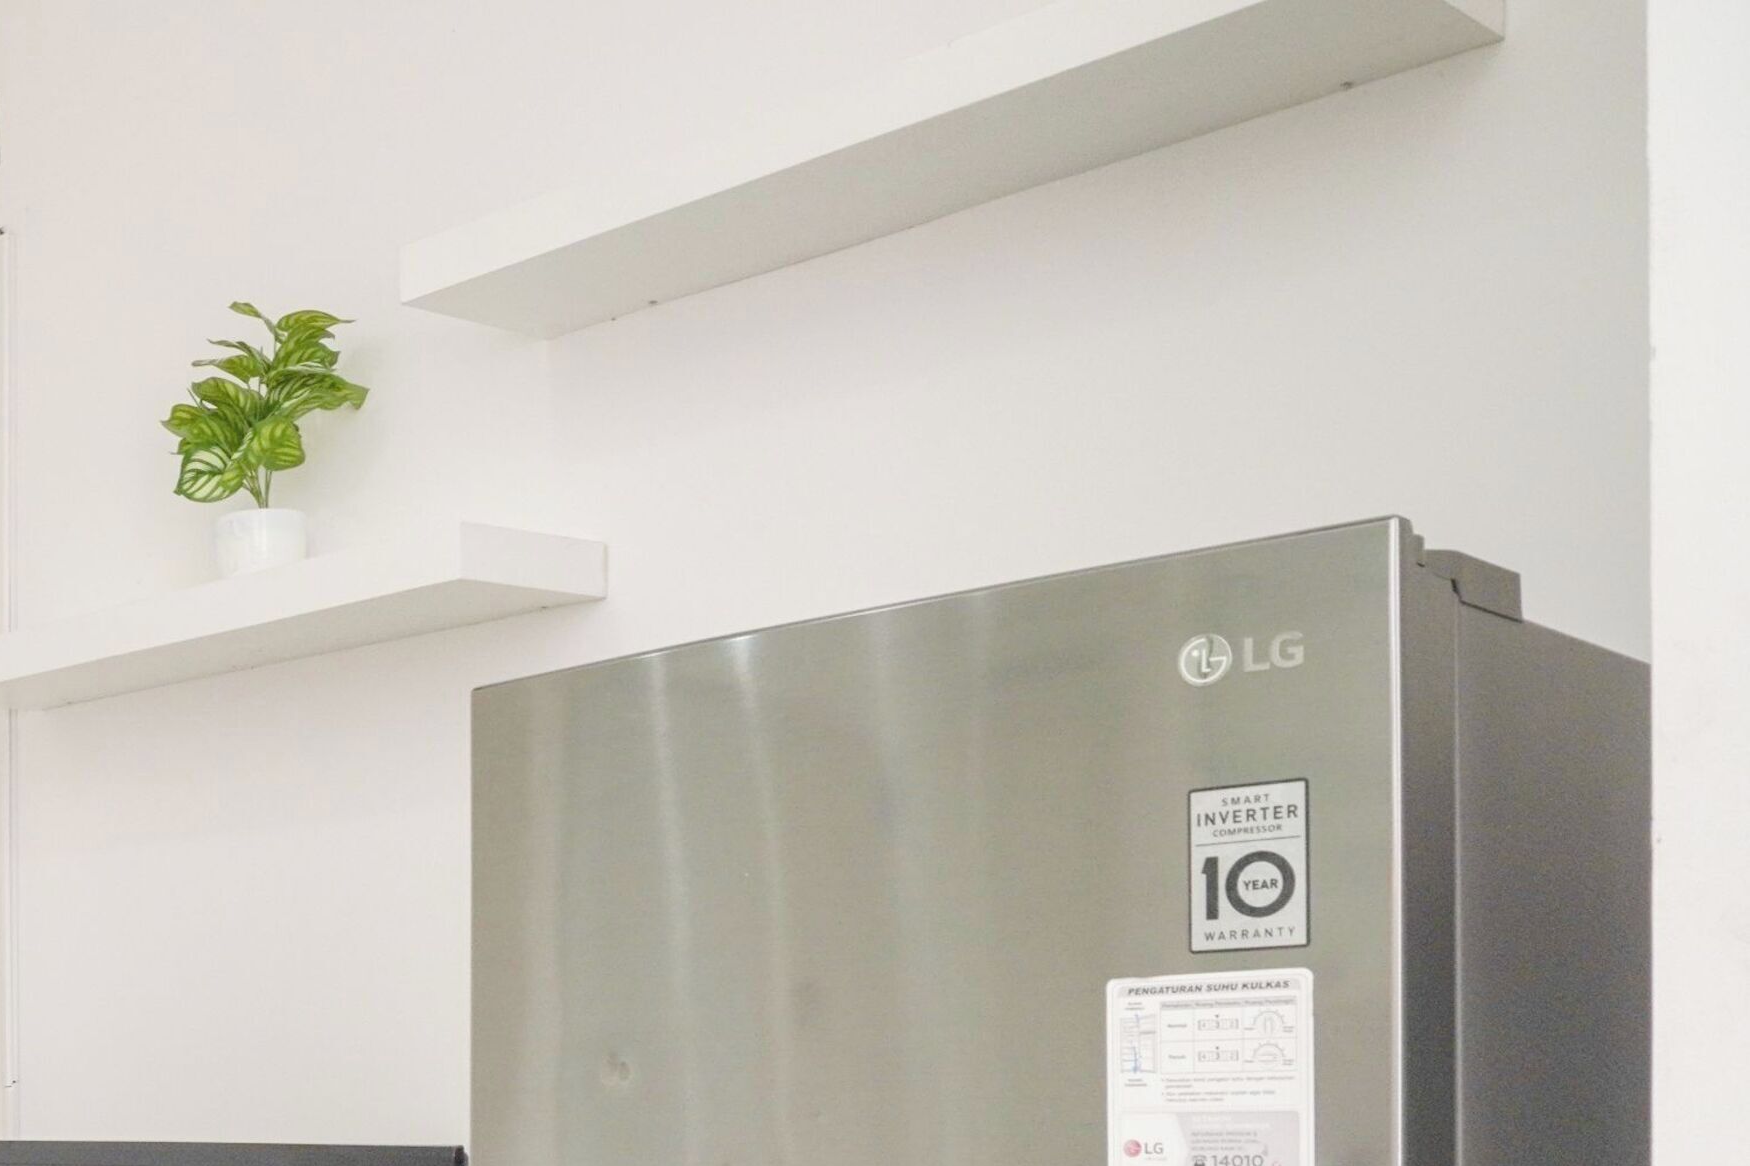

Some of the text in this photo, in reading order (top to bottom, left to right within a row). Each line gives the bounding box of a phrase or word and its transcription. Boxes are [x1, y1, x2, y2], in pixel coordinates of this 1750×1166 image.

[1243, 630, 1305, 672] LG
[1222, 793, 1270, 807] SMART
[1196, 804, 1299, 827] INVERTER
[1212, 824, 1283, 838] COMPRESSOR
[1201, 850, 1296, 921] 10
[1243, 878, 1279, 891] YEAR
[1204, 926, 1296, 942] WARRANTY
[1128, 980, 1291, 996] PENGATURAN SUHU KULKAS
[1144, 1142, 1164, 1155] LG
